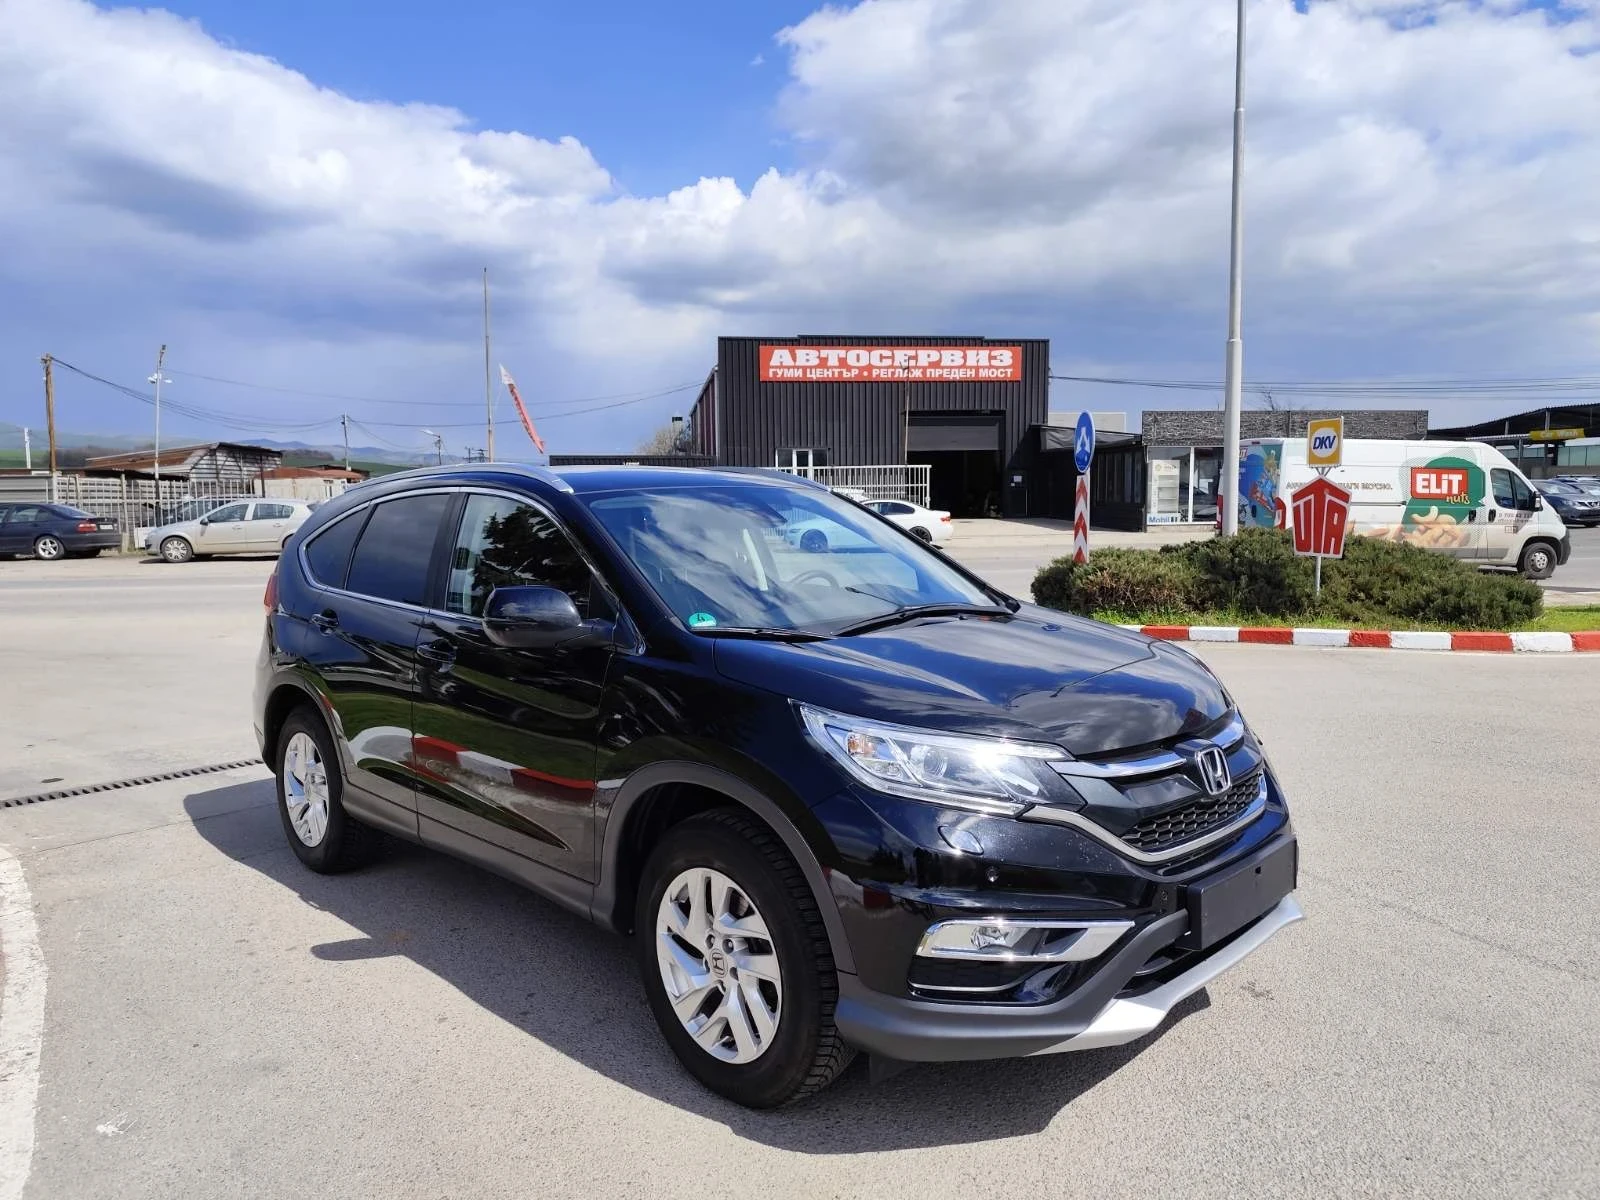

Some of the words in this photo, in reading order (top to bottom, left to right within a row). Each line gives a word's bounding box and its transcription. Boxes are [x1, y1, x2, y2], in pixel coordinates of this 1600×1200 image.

[769, 349, 1013, 367] АВТОСЕРВИЗ
[769, 368, 803, 378] ГУМИ
[806, 368, 859, 380] ЦЕНТЪР
[872, 368, 923, 378] РЕГЛАЖ
[926, 368, 975, 380] ПРЕДЕН
[979, 368, 1013, 378] МОСТ
[1312, 435, 1337, 450] DKV
[1446, 491, 1470, 504] nuts
[1148, 515, 1170, 524] Mobil
[1292, 479, 1352, 555] UTA
